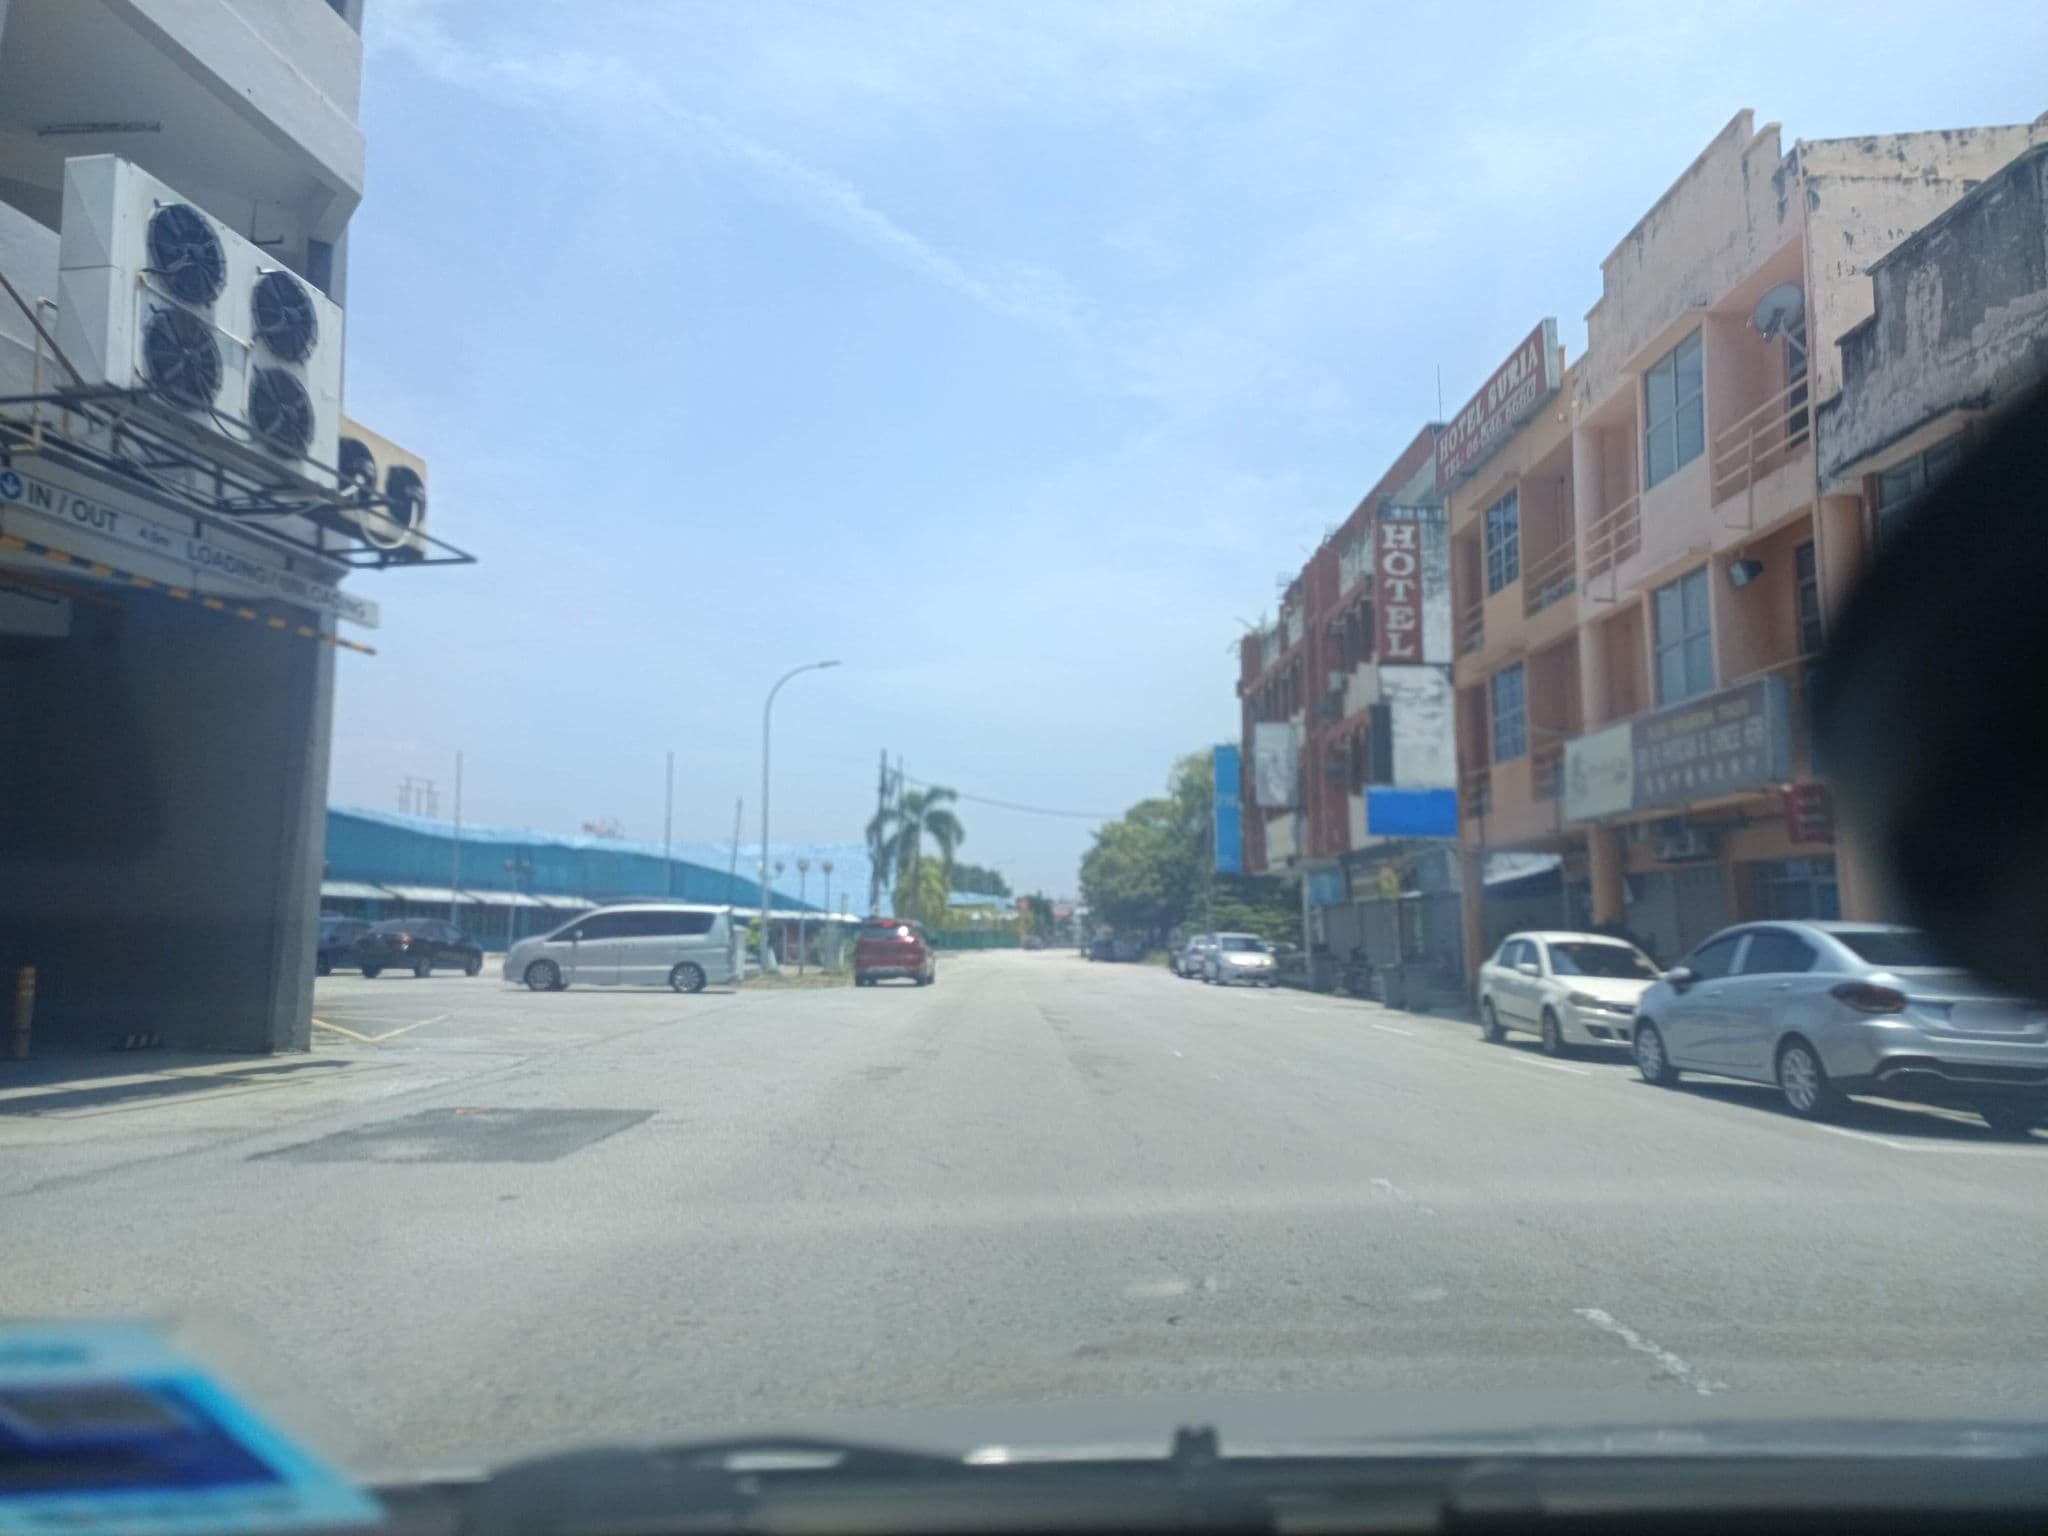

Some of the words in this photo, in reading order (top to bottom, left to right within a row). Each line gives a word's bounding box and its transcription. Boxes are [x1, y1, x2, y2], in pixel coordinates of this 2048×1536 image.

[1439, 398, 1484, 464] HOTEL
[1487, 340, 1538, 416] SURIA
[28, 482, 52, 509] IN
[72, 499, 118, 532] OUT
[1382, 523, 1416, 657] HOTEL
